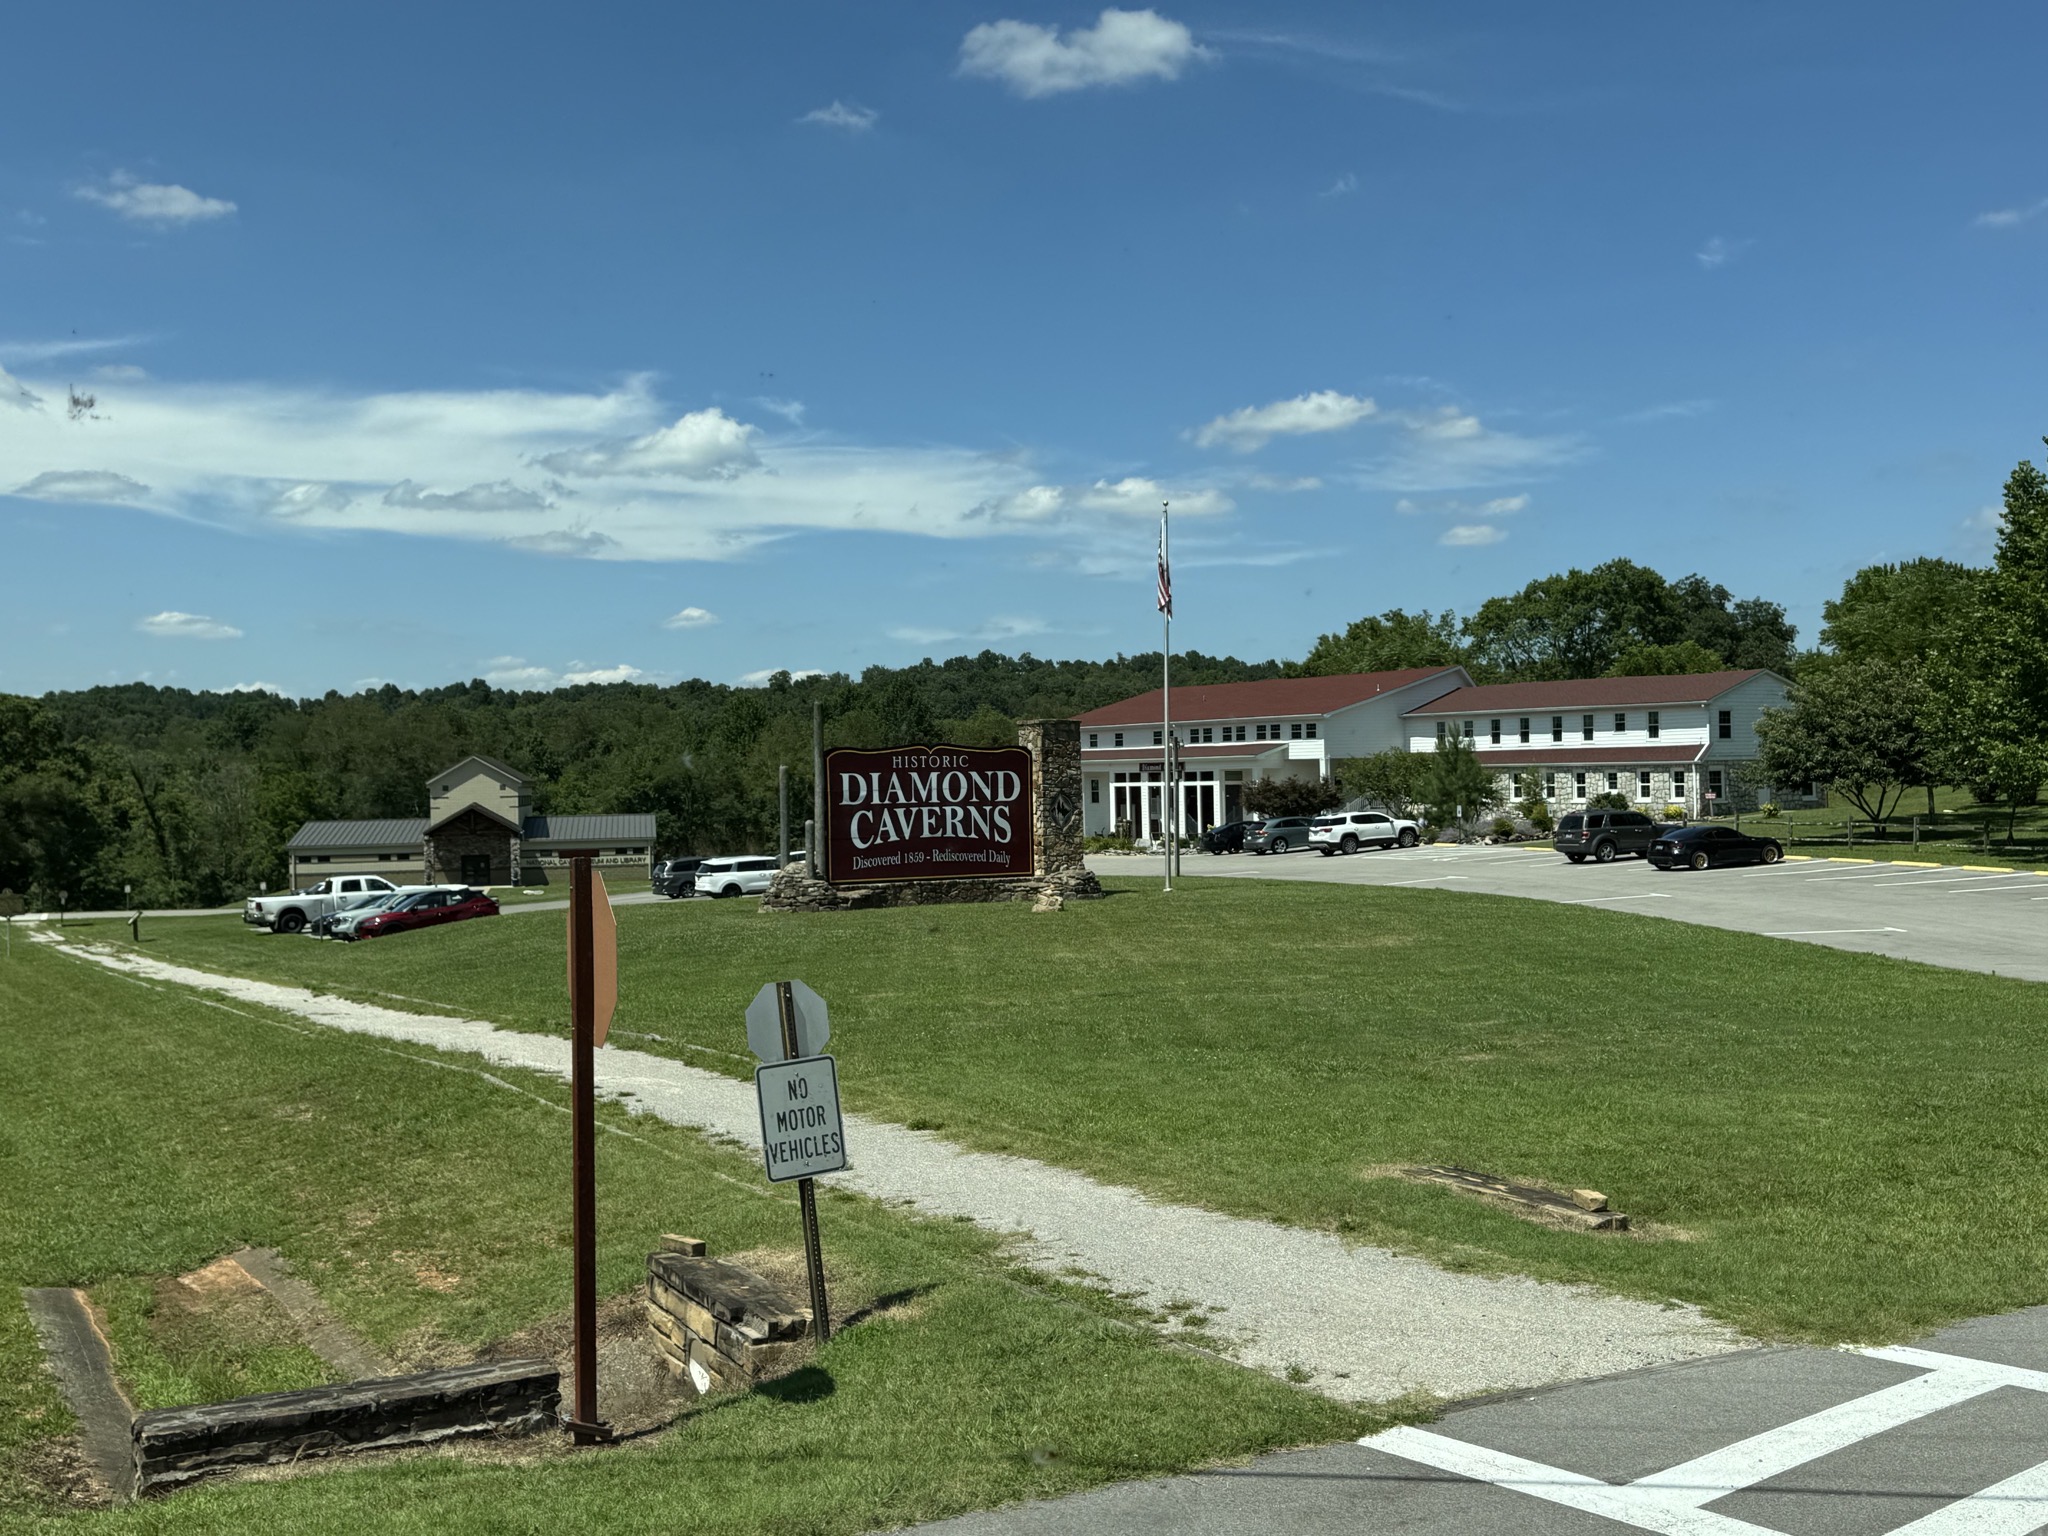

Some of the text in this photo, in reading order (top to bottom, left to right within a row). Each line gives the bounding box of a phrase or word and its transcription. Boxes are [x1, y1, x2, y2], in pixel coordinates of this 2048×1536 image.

[892, 755, 969, 768] HISTORIC
[839, 770, 1021, 806] DIAMOND
[850, 805, 1012, 849] CAVERNS
[619, 856, 647, 864] LIBRARY
[852, 851, 901, 870] Discovered
[904, 851, 925, 863] 1859
[932, 849, 987, 863] Rediscovered
[988, 849, 1011, 868] Daily
[787, 1077, 808, 1101] NO
[776, 1105, 826, 1133] MOTOR
[768, 1132, 840, 1164] VEHICLES
